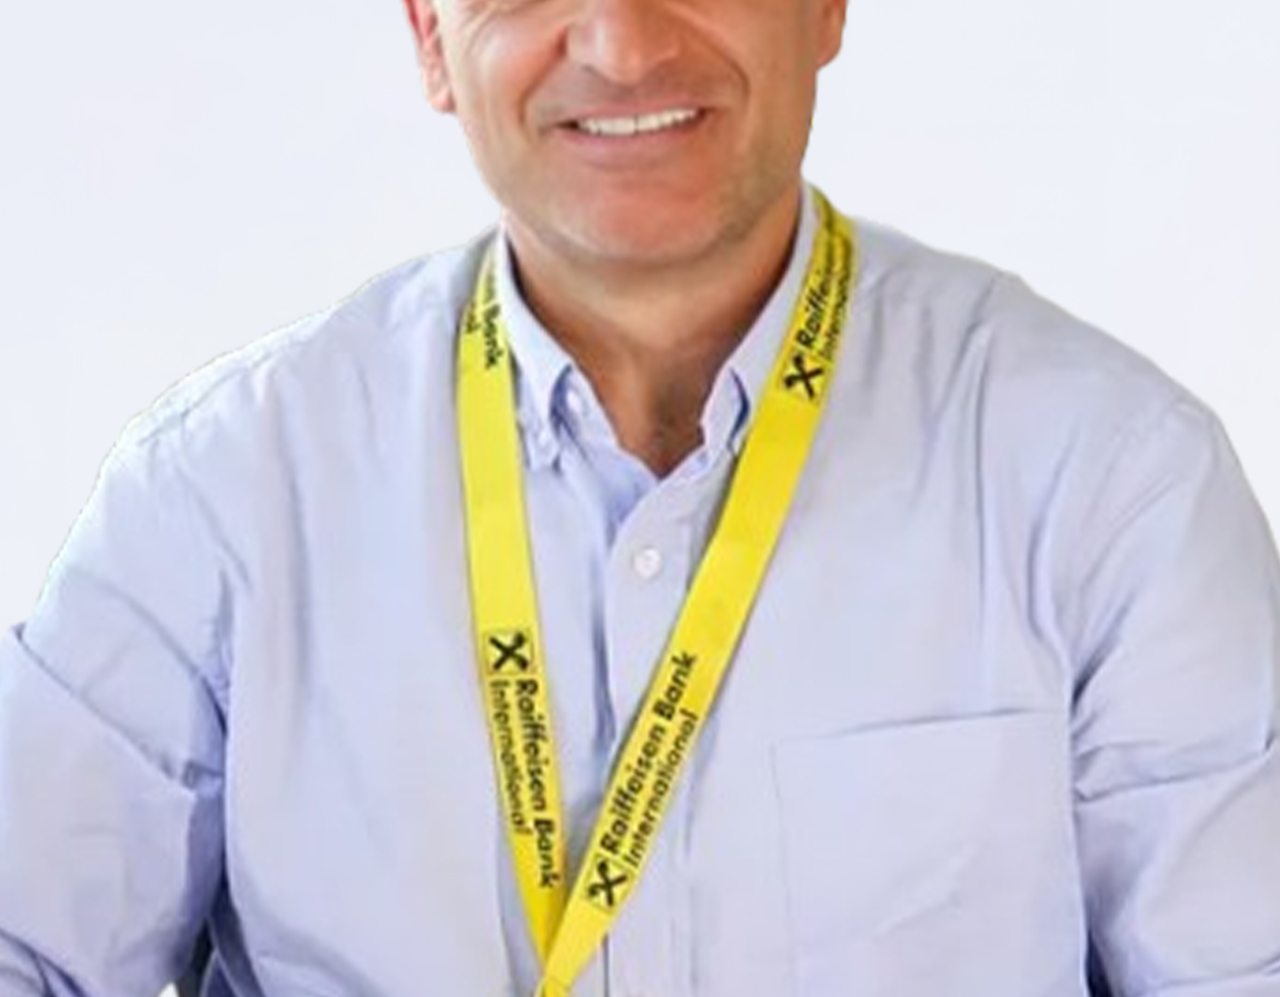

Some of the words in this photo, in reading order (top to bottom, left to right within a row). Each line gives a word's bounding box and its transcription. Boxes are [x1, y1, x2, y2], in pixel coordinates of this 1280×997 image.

[489, 680, 533, 836] International
[516, 679, 549, 812] Raiffeisen
[533, 818, 560, 889] Bank
[600, 722, 666, 855] Raiffeisen
[652, 651, 697, 721] Bank
[623, 708, 699, 868] International
